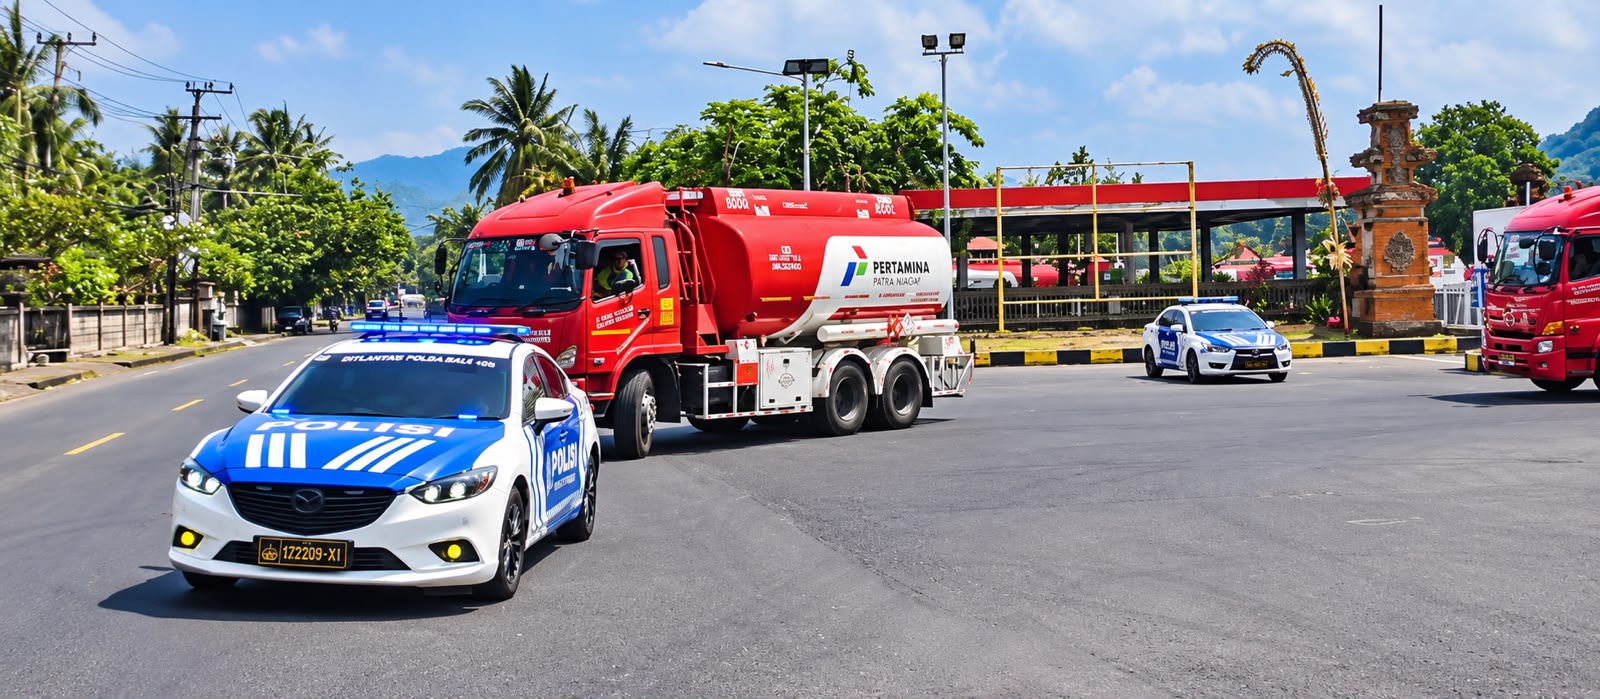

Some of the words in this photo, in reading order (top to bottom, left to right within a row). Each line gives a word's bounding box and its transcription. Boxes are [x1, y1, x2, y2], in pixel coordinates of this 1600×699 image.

[873, 261, 930, 274] PERTAMINA
[873, 277, 894, 286] PATRA
[405, 355, 444, 363] POLDA
[256, 421, 455, 437] POLISI
[552, 442, 577, 475] POLISI
